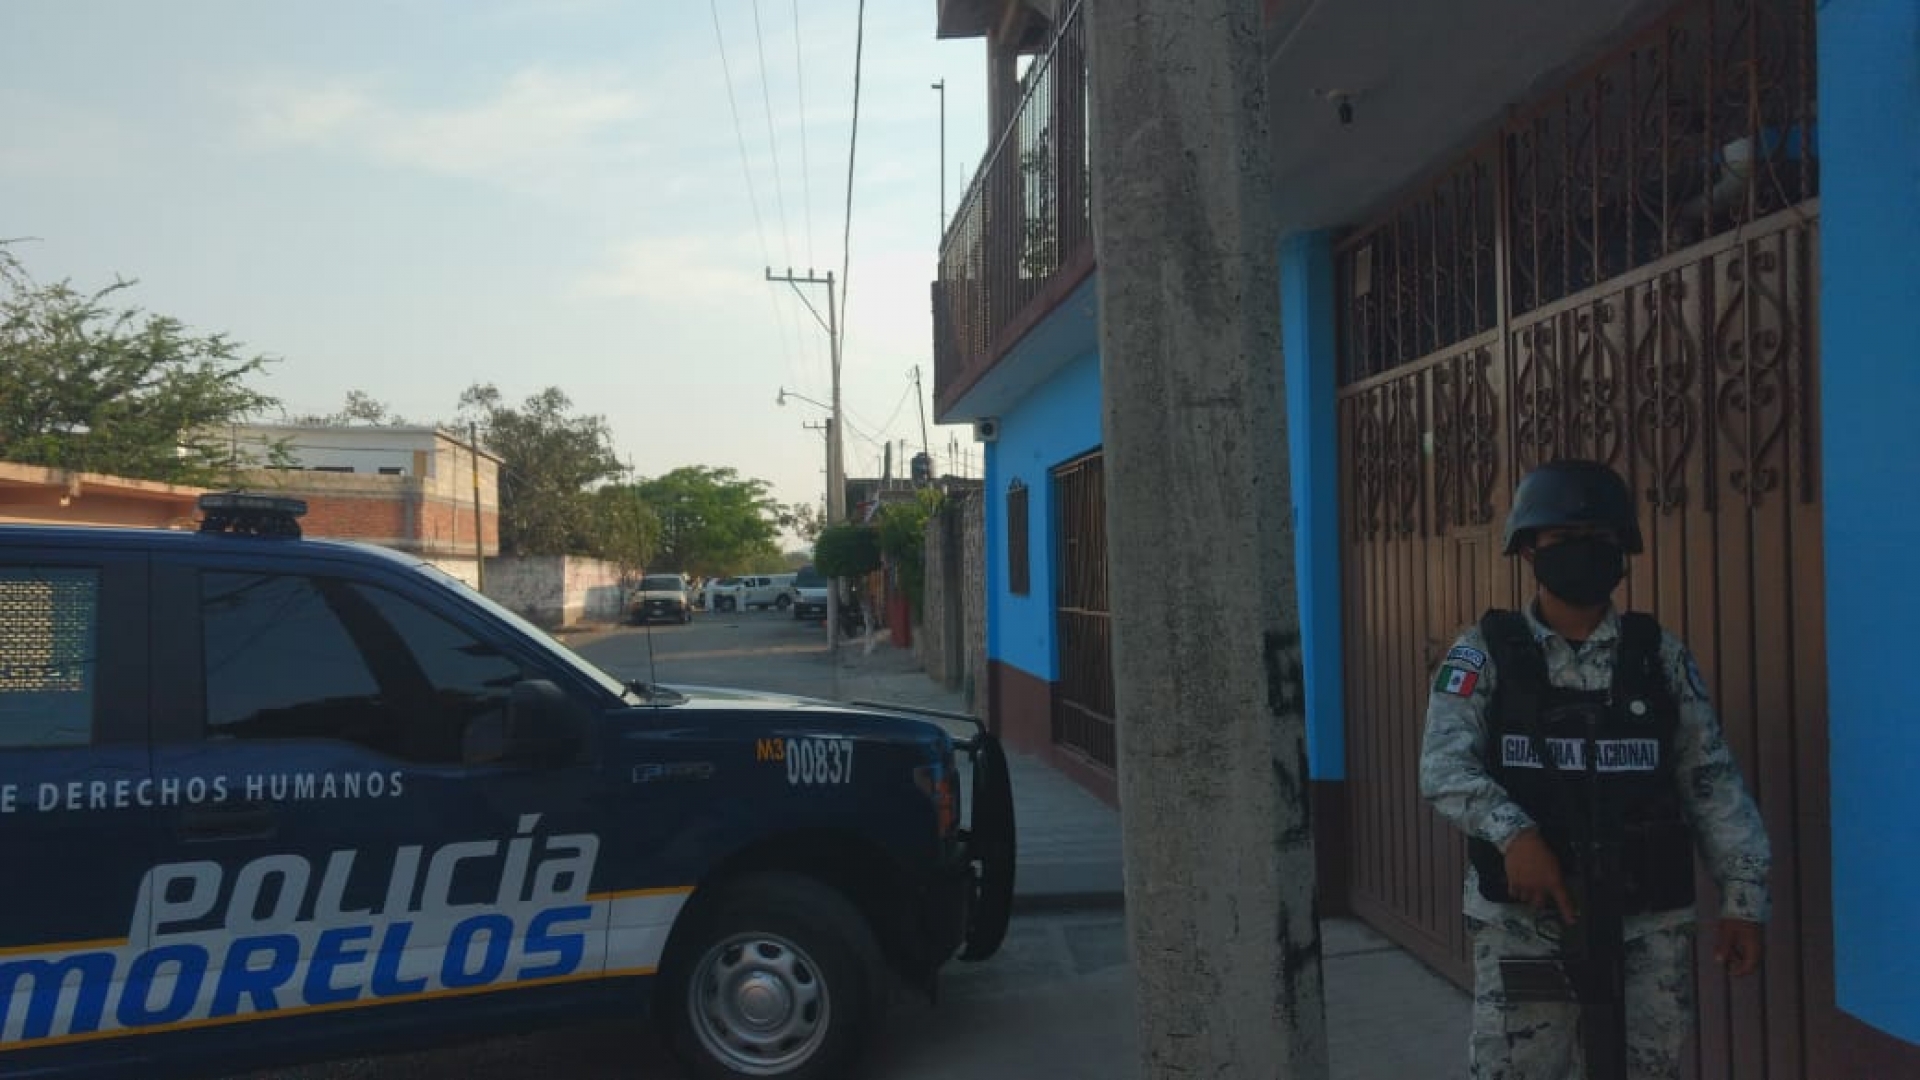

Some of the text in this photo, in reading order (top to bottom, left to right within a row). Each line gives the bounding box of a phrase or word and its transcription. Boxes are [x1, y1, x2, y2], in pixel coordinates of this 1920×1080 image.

[756, 738, 853, 784] M3 00837
[1505, 738, 1576, 767] GUADIA
[38, 775, 228, 811] DERECHOS
[246, 771, 404, 802] HUMANOS
[0, 905, 594, 1041] MORELOS
